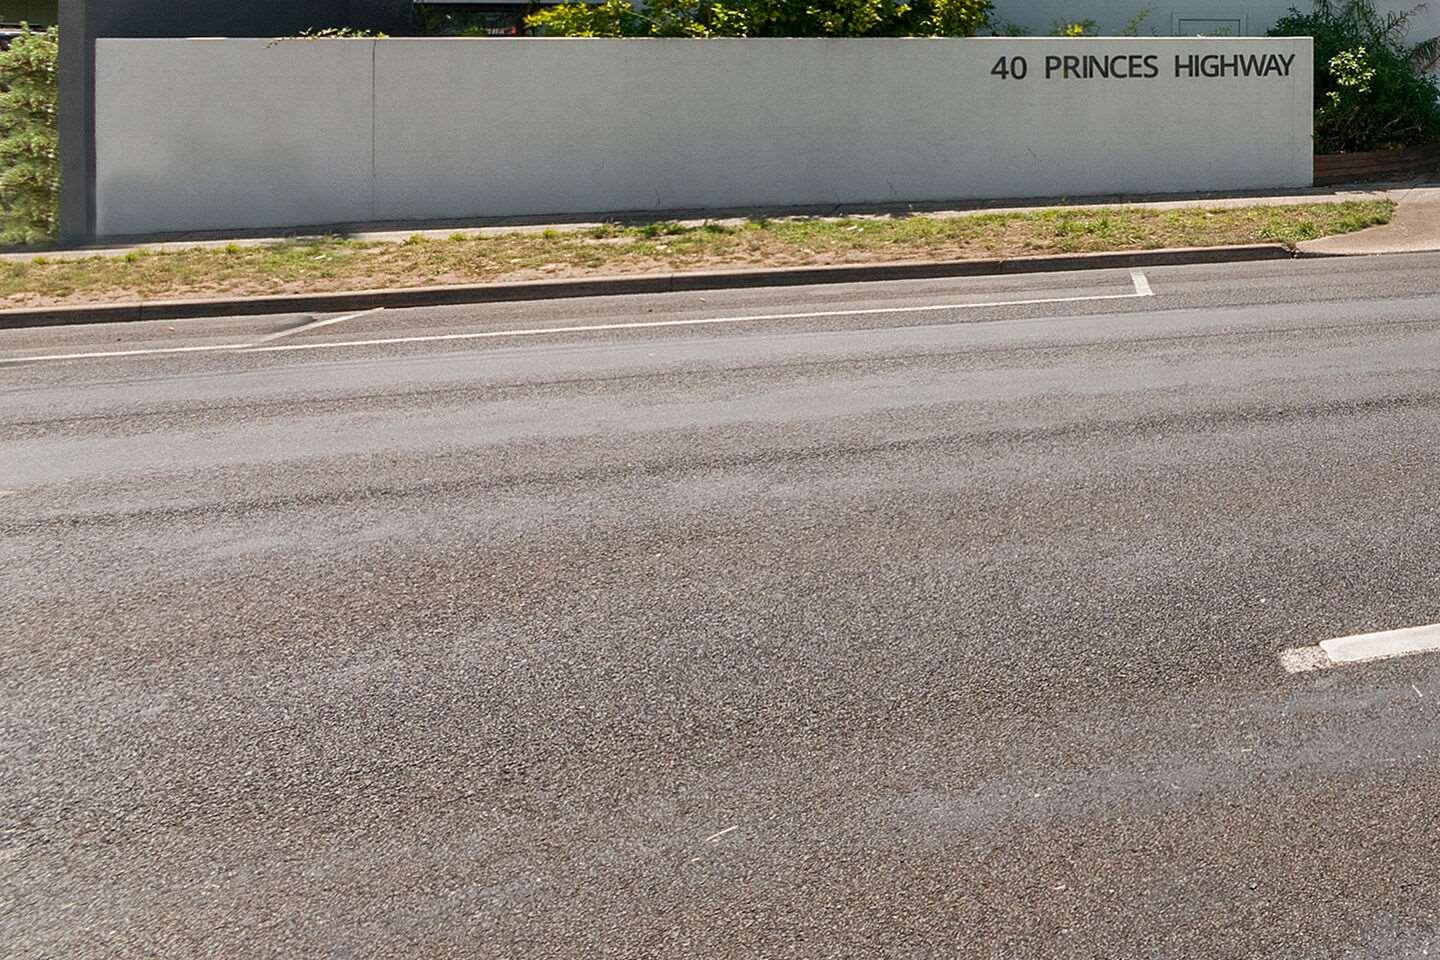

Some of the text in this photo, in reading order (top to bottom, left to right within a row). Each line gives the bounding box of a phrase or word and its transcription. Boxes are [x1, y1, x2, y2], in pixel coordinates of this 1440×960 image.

[990, 54, 1296, 80] 40 PRINCES HIGHWAY
